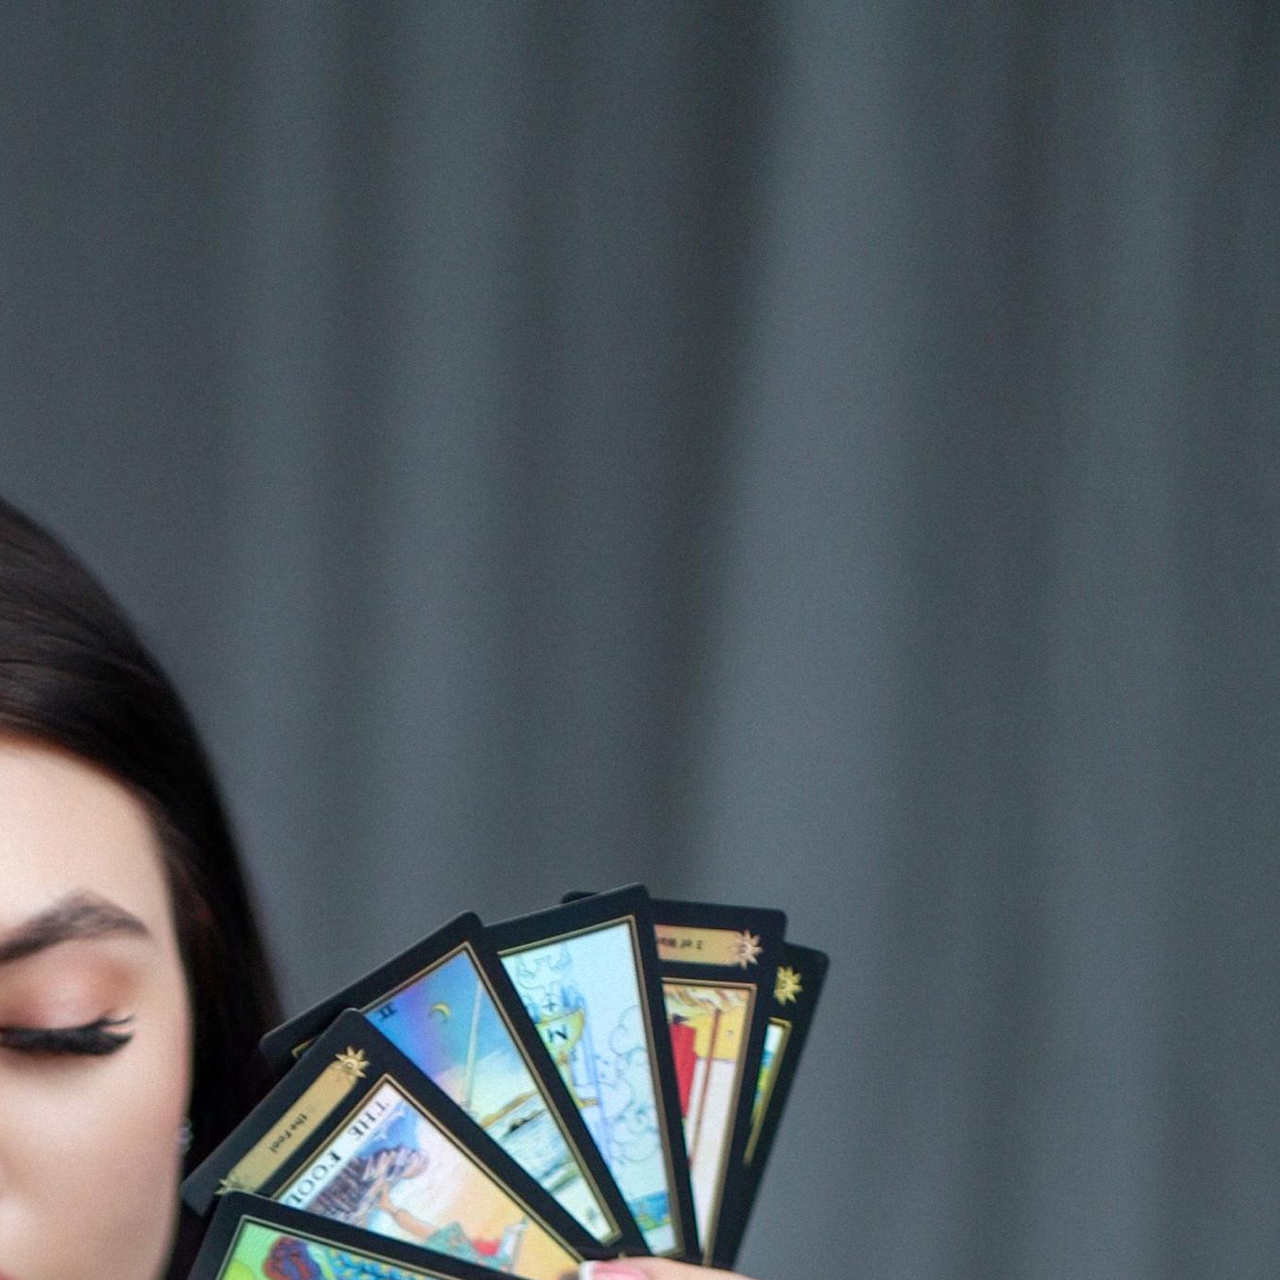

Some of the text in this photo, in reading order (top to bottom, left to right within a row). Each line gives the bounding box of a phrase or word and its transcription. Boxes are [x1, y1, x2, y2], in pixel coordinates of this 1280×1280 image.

[268, 1129, 292, 1154] Fool
[284, 1100, 390, 1204] THE FOOL
